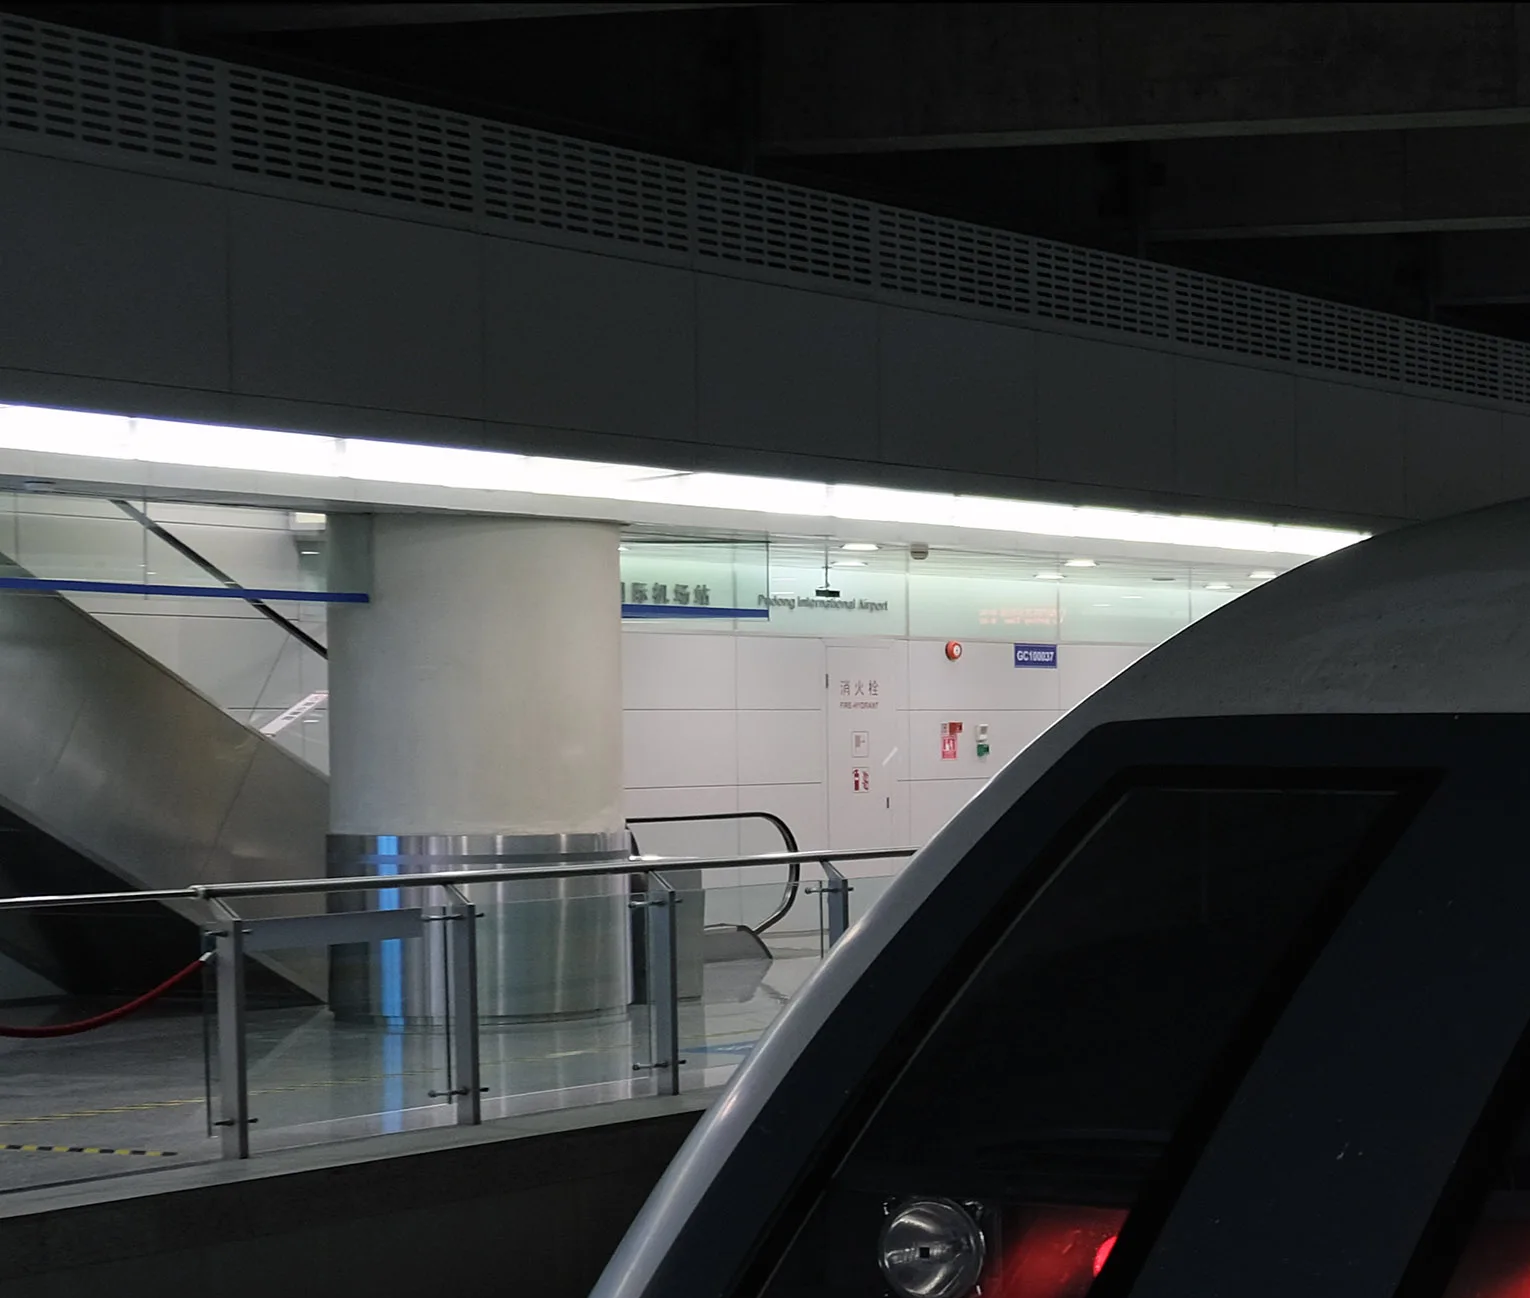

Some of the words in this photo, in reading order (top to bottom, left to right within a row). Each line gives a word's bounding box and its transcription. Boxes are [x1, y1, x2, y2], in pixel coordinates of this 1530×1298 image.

[757, 593, 796, 610] Pudong
[797, 595, 856, 611] International
[858, 597, 889, 612] Airport
[840, 679, 879, 696] 消火栓
